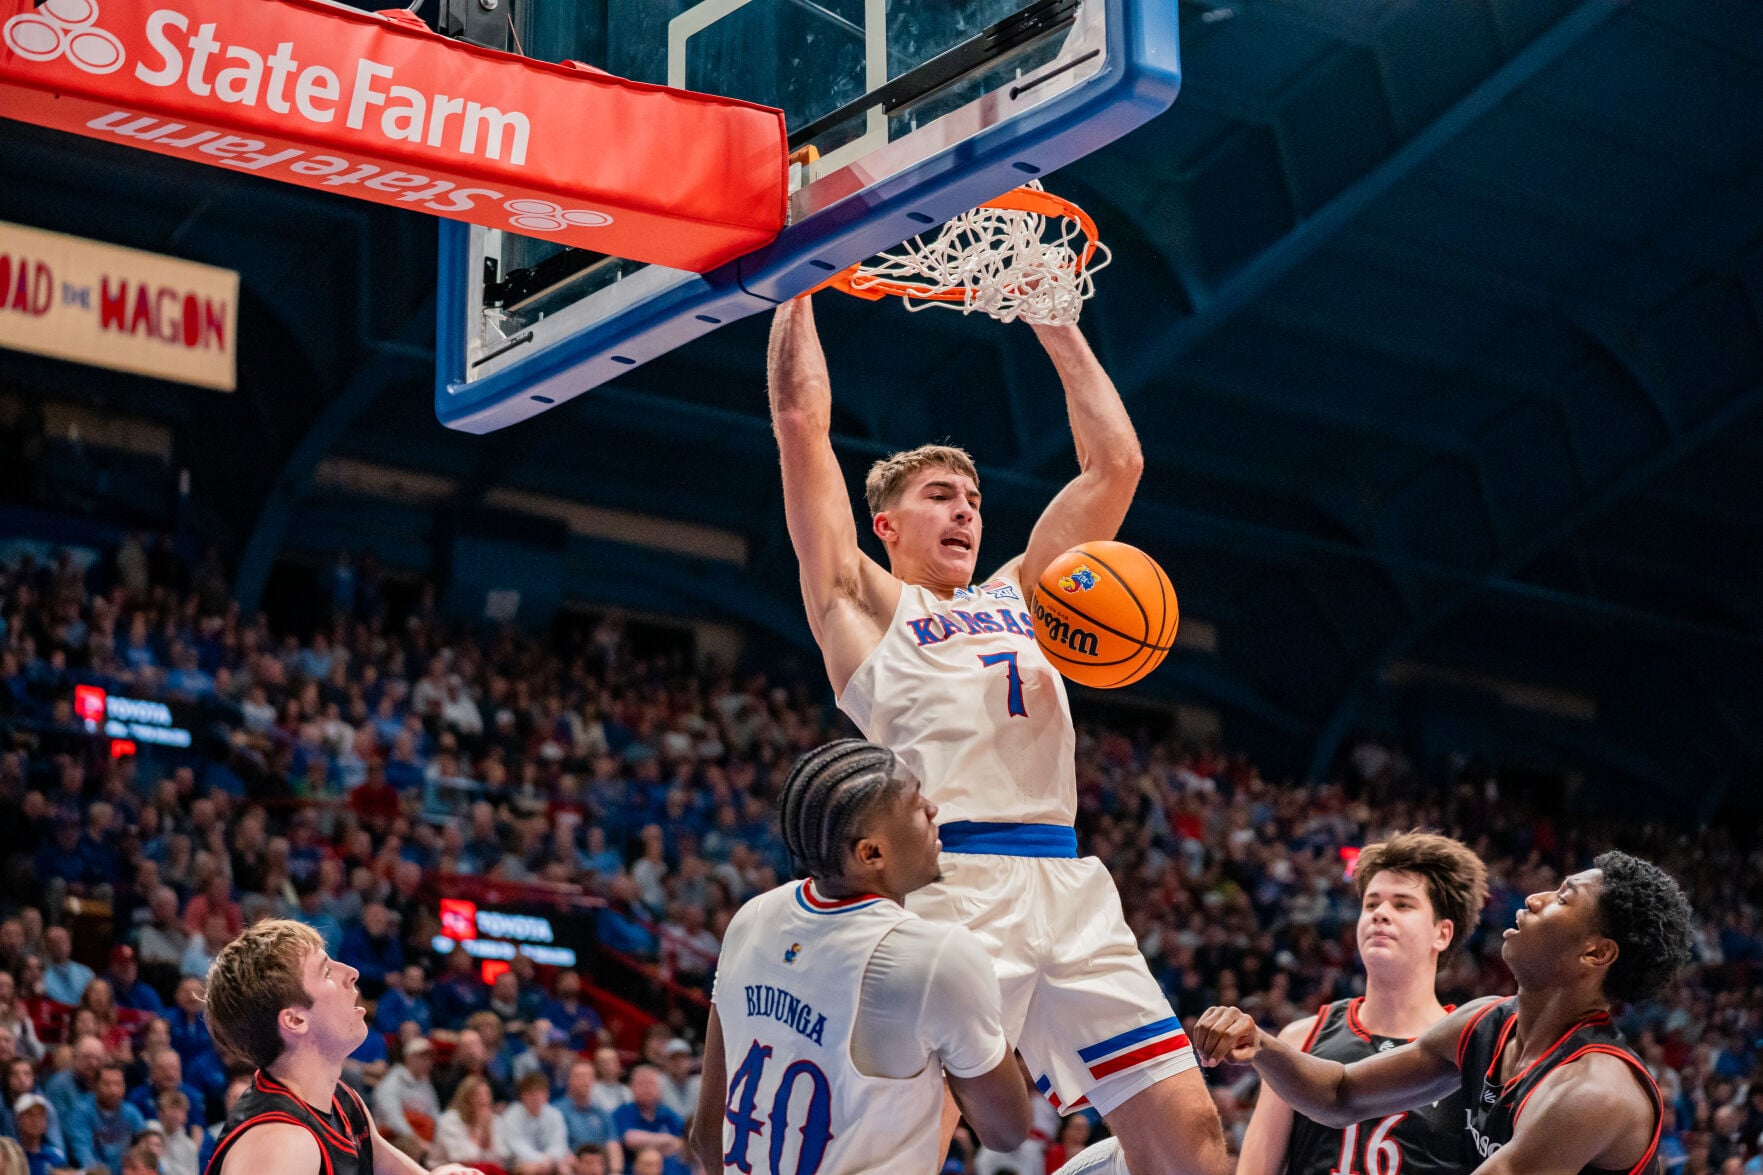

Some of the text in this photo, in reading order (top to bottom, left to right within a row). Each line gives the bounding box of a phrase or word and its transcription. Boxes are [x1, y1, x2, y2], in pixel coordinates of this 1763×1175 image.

[100, 272, 228, 352] WAGON
[905, 608, 1035, 647] KANSAS
[106, 695, 172, 727] TOYOTA
[977, 651, 1029, 718] 7
[475, 910, 554, 943] TOYOTA
[745, 984, 828, 1047] BIDUNGA
[723, 1038, 834, 1175] 40
[1330, 1111, 1408, 1175] 16
